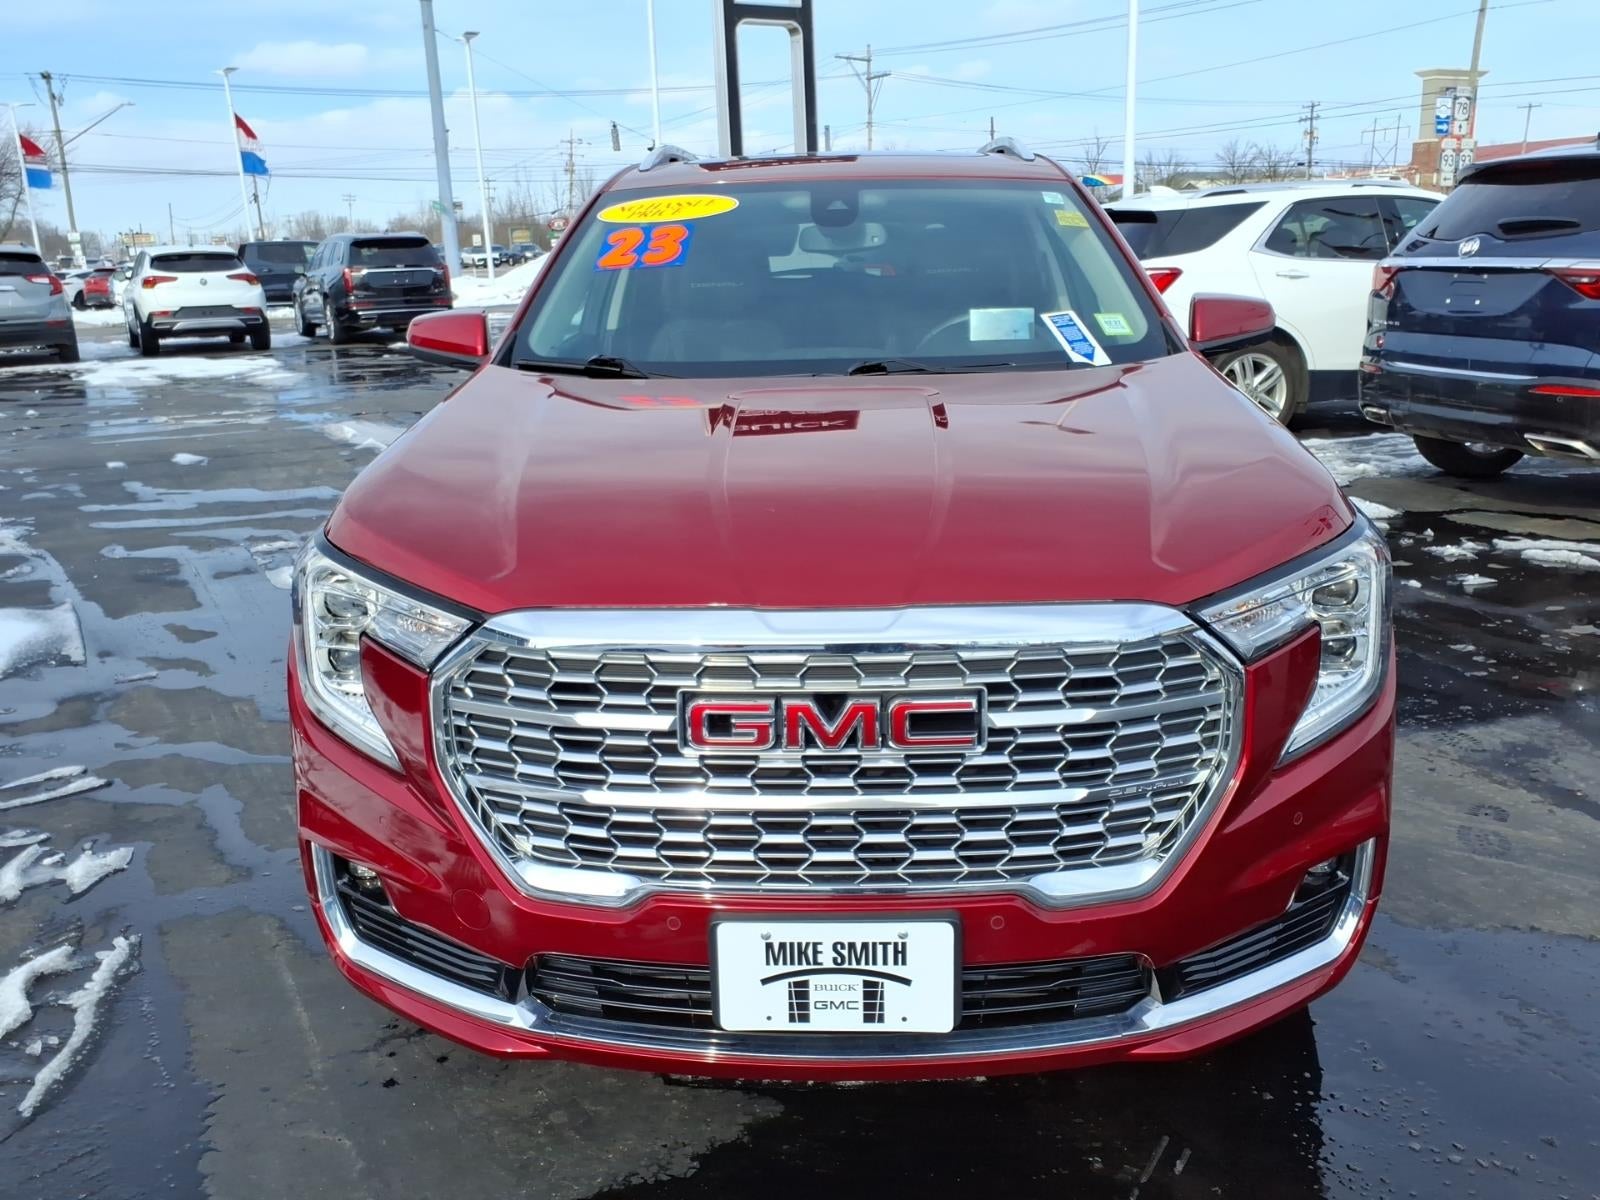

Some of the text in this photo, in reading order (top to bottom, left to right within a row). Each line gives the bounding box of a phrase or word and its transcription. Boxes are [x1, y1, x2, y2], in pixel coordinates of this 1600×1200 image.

[1457, 102, 1468, 115] 78
[1443, 153, 1454, 167] 93
[597, 224, 688, 269] 23
[688, 699, 977, 751] GMC
[765, 941, 908, 966] MIKE SMITH
[814, 984, 858, 992] BUICK
[813, 1000, 859, 1010] GMC
